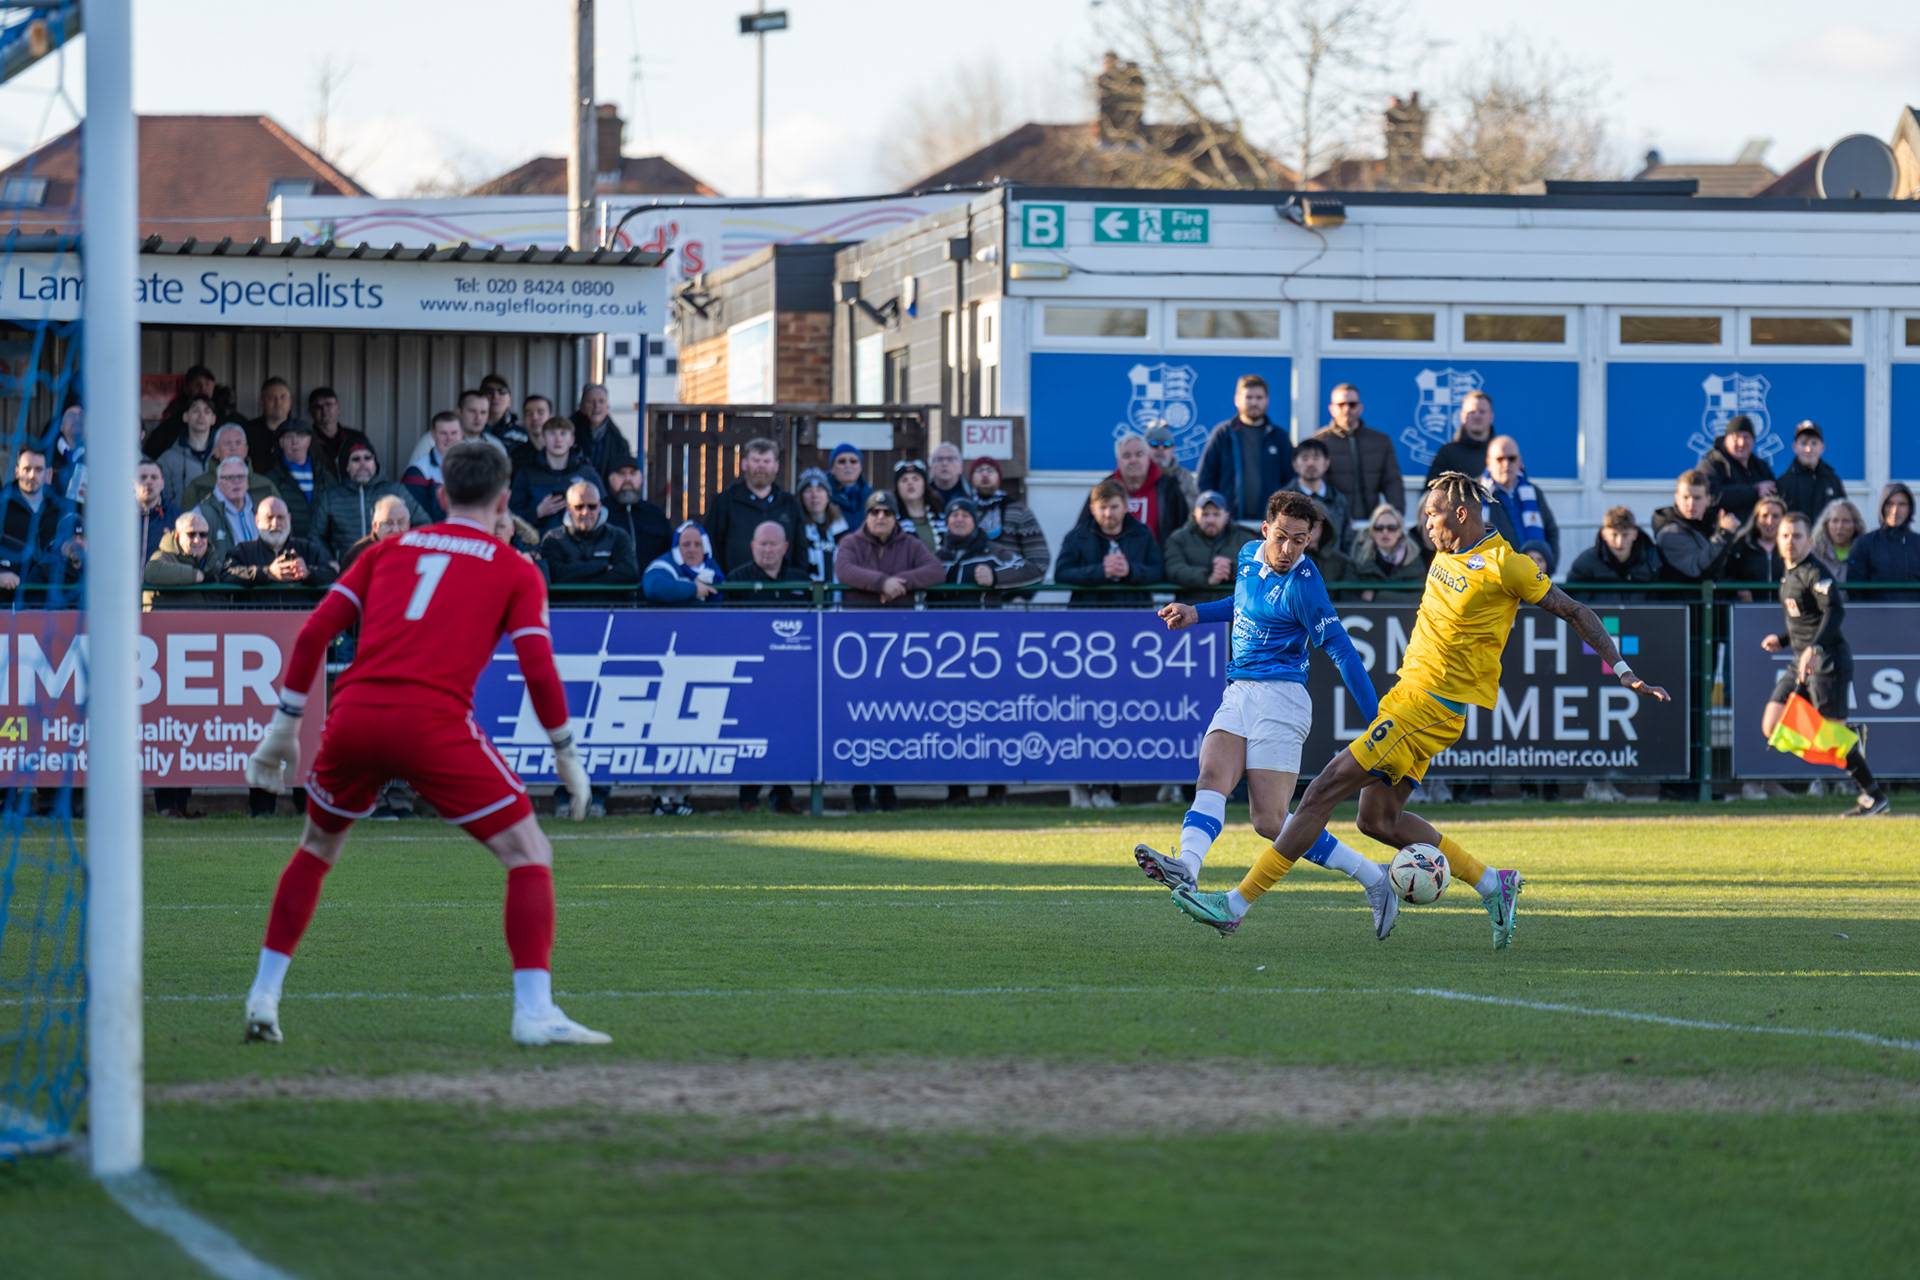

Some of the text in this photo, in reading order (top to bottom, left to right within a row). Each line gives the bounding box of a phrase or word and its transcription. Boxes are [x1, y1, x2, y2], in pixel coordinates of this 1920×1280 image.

[1028, 208, 1058, 244] B
[1172, 210, 1203, 226] Fire
[1172, 227, 1202, 241] exit
[19, 267, 384, 314] Lamate Specialists
[455, 277, 614, 296] Tel: 020 8424 0800
[421, 298, 647, 318] www.nagleflooring.co.uk
[966, 424, 1008, 445] EXIT
[404, 552, 452, 621] 1
[832, 631, 1216, 679] 07525 538 341
[847, 694, 1201, 728] www.cgscaffolding.co.uk
[1333, 686, 1640, 741] LIMER
[203, 715, 274, 742] timbe
[1371, 719, 1394, 742] 6
[737, 745, 767, 758] LTD
